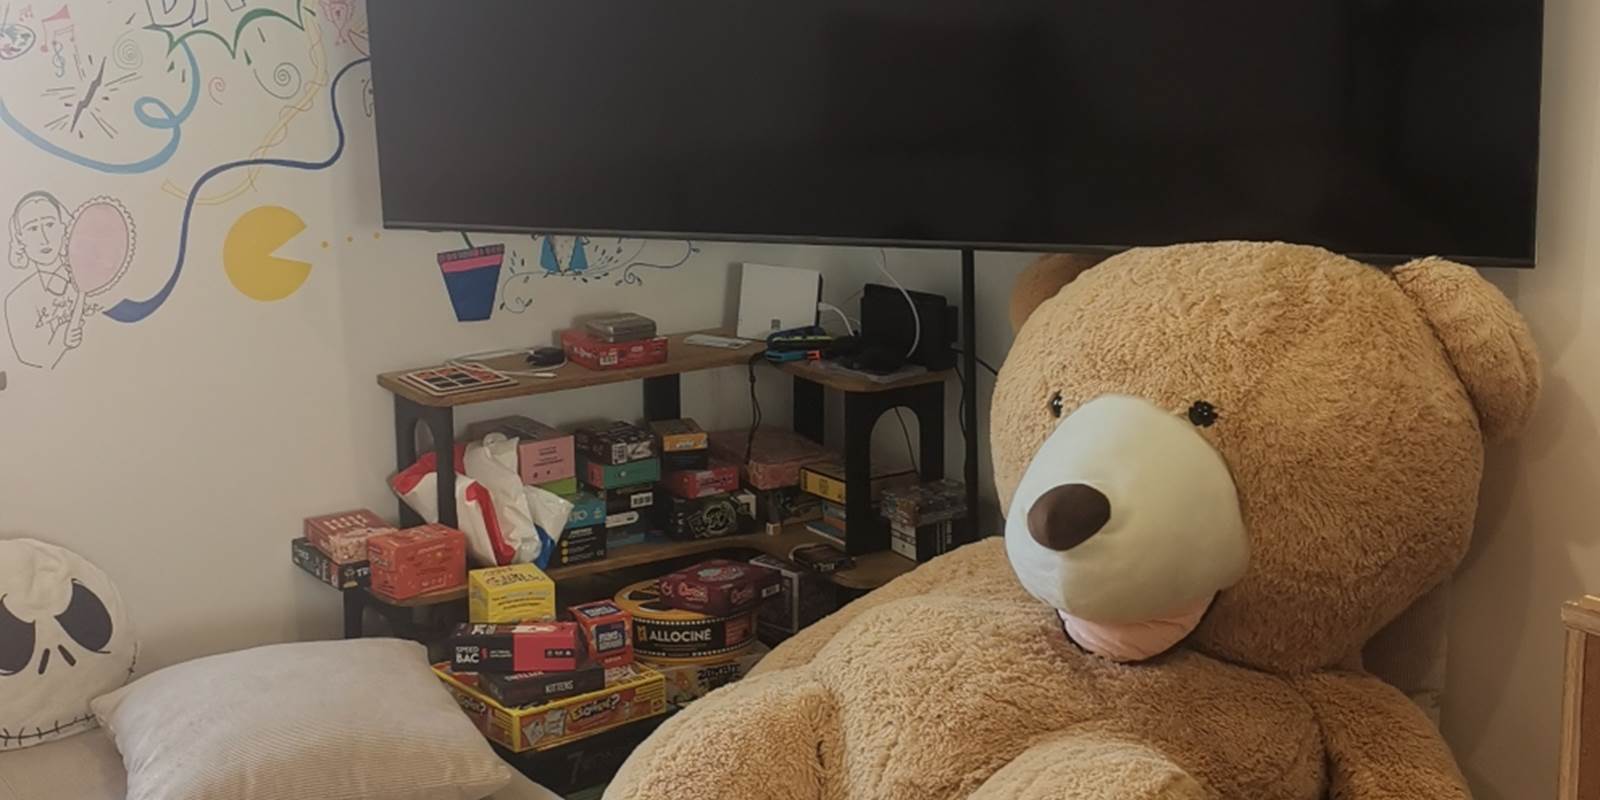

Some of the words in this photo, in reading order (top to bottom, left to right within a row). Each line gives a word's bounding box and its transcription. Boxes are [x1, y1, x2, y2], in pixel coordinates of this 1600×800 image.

[649, 628, 712, 643] ALLOCINÉ
[455, 653, 480, 664] BAC
[545, 680, 574, 693] KITTENS
